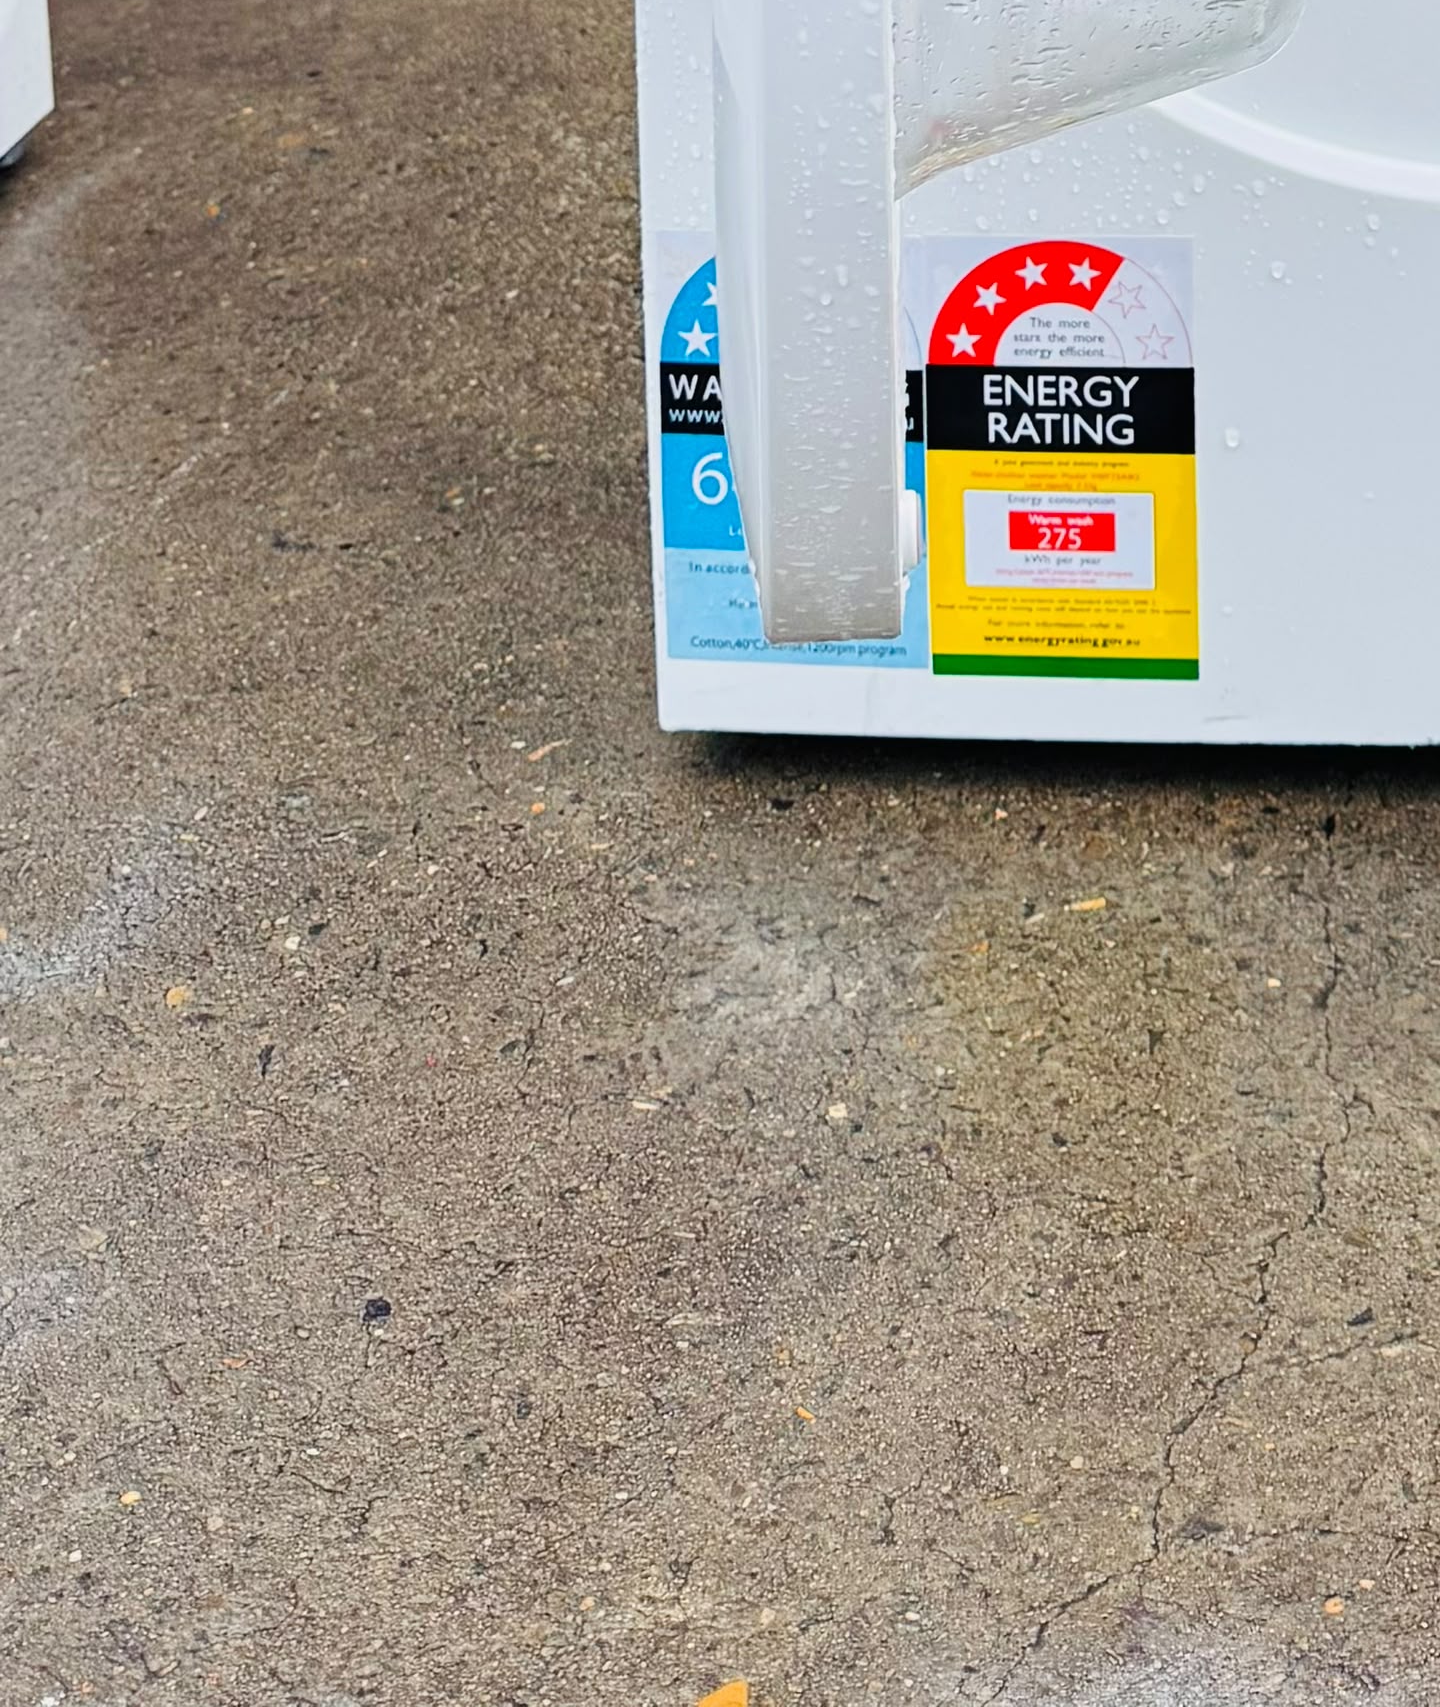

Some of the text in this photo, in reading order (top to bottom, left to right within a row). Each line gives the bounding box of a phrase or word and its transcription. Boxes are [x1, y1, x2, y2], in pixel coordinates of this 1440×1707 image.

[1029, 317, 1091, 328] The more
[1047, 332, 1067, 343] the
[1073, 334, 1105, 343] more
[1014, 346, 1104, 359] energy efficient
[982, 374, 1139, 407] ENERGY
[987, 412, 1135, 445] RATING
[1007, 494, 1116, 506] Energy consumption
[1028, 514, 1094, 526] Warm wash
[1037, 528, 1082, 549] 275
[1024, 555, 1102, 567] kWh per year
[857, 645, 907, 657] program
